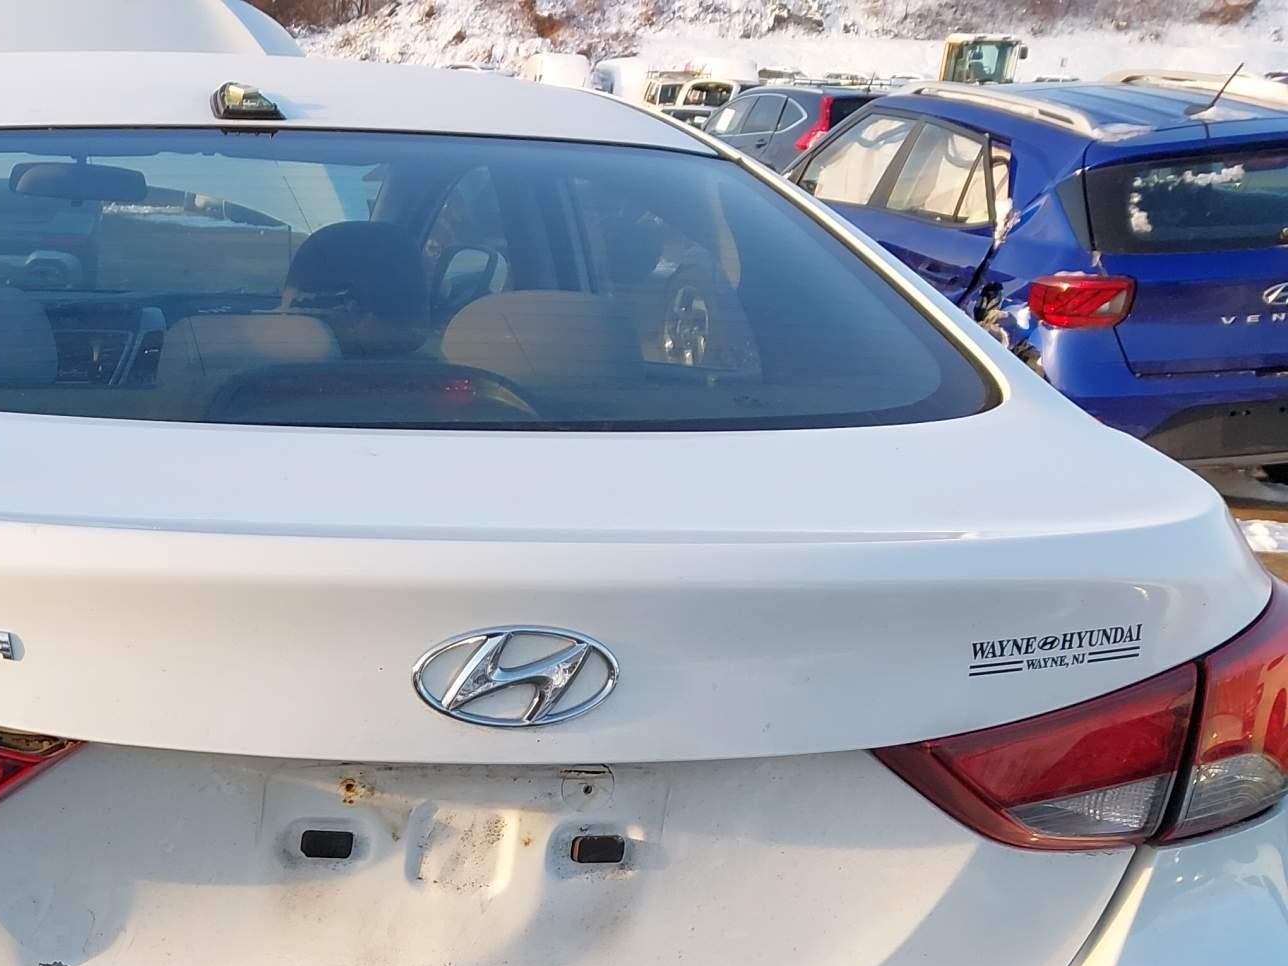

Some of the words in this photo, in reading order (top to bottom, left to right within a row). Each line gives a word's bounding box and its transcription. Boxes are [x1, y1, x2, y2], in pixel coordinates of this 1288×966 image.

[971, 636, 1037, 661] WAYNE
[1060, 624, 1143, 651] HYUNDAI
[1026, 655, 1070, 671] WAYNE,
[1071, 653, 1086, 666] NJ
